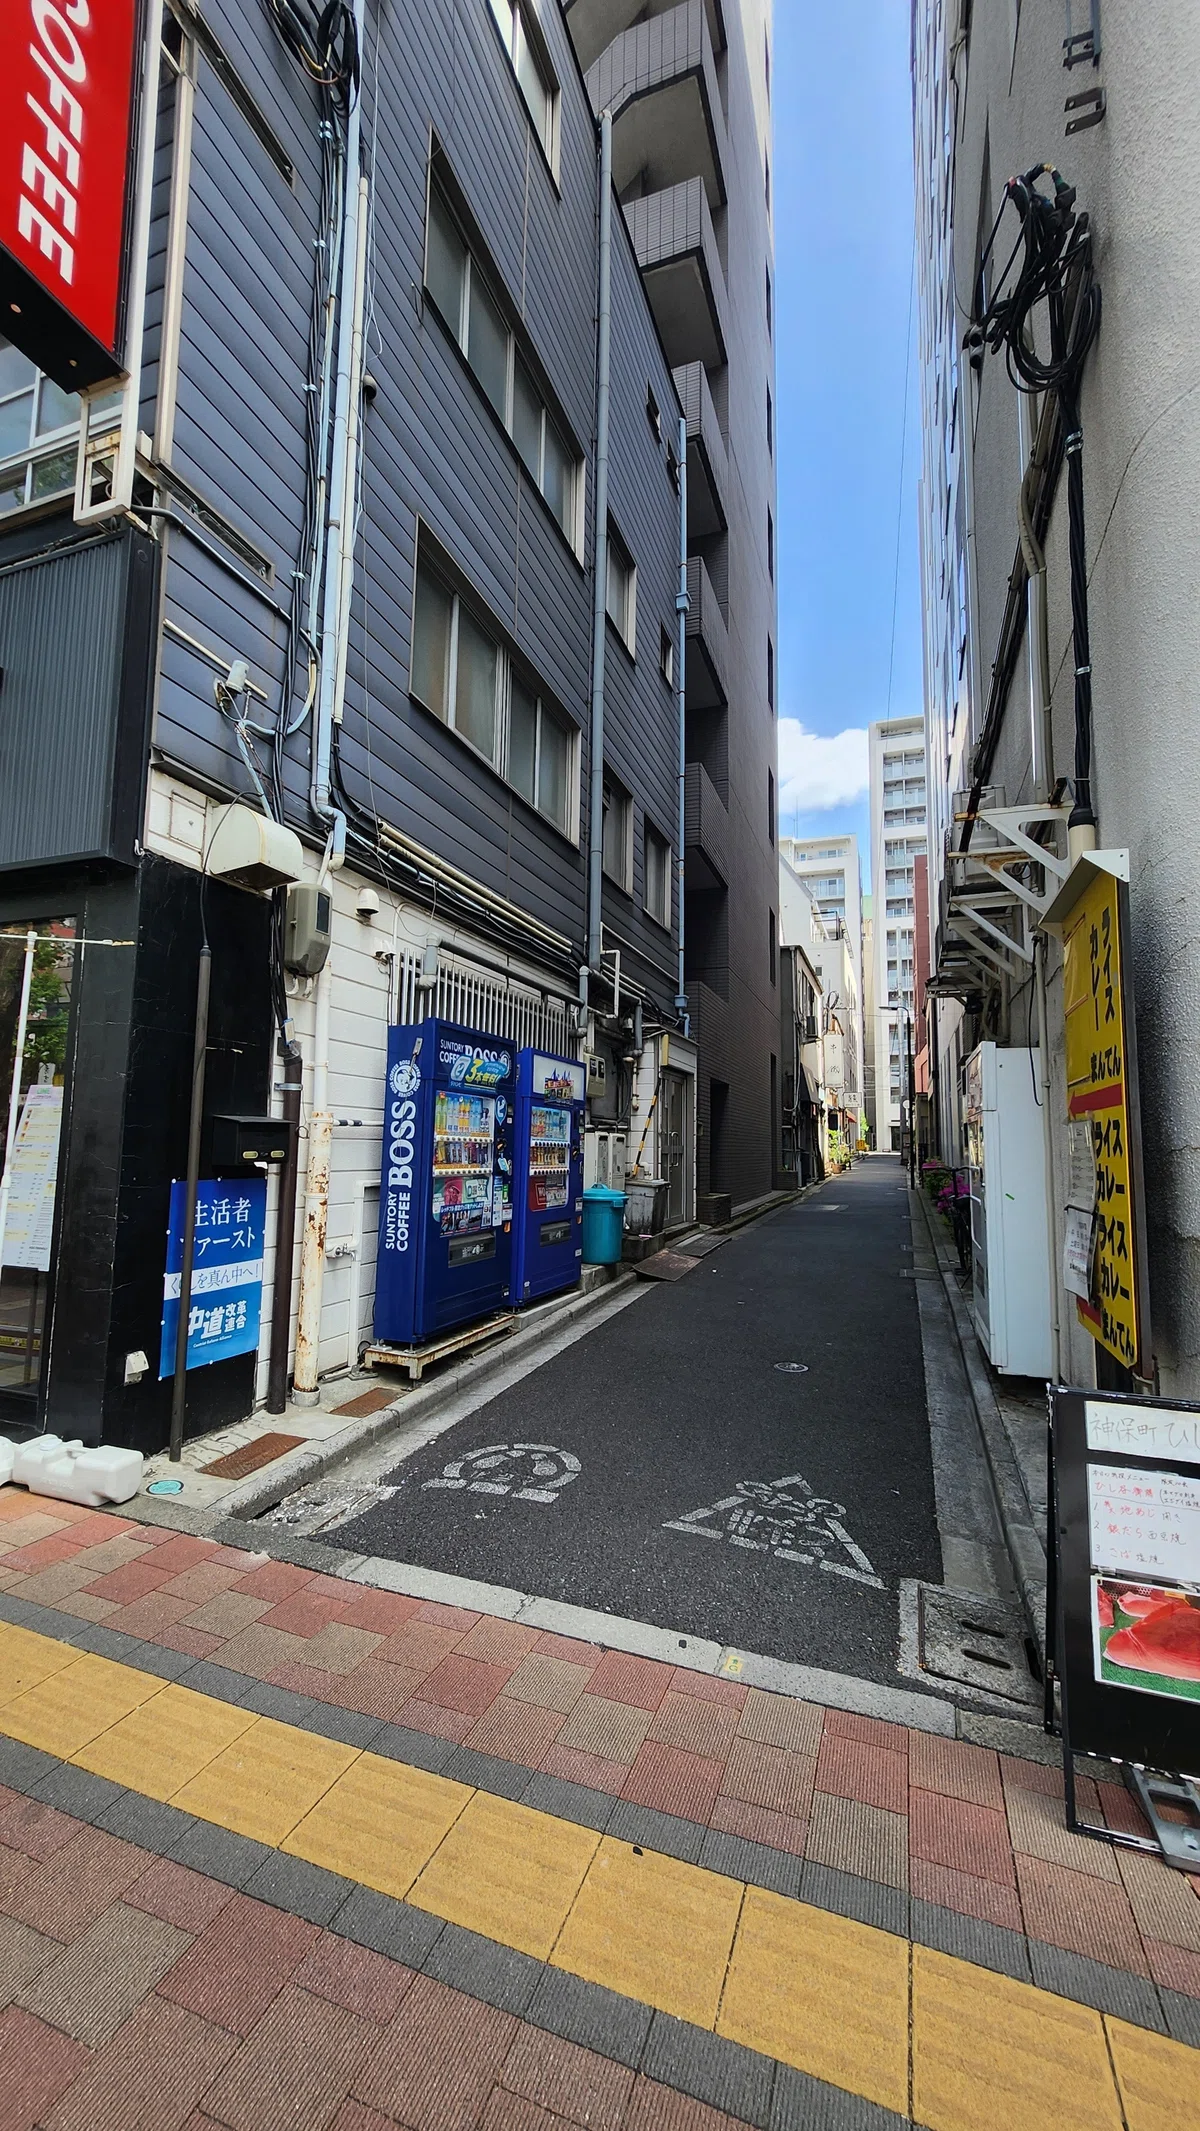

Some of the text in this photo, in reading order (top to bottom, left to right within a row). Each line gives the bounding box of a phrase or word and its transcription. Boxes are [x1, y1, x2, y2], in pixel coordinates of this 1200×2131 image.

[1090, 923, 1100, 1032] カレー
[1102, 906, 1115, 1024] ライス
[439, 1050, 461, 1065] COFF
[440, 1039, 465, 1053] SUNTORY
[1090, 1045, 1121, 1084] まんてん
[388, 1100, 416, 1188] BOSS
[1096, 1162, 1126, 1204] カレー
[385, 1191, 397, 1250] SUNTORY
[396, 1192, 411, 1252] COFFEE
[1100, 1214, 1129, 1263] ライス
[179, 1226, 257, 1258] ァースト
[170, 1264, 259, 1295] くを真ん中へ!
[1101, 1256, 1130, 1301] カレー
[224, 1315, 247, 1333] 連合
[225, 1300, 247, 1316] 改革
[1102, 1309, 1135, 1359] まんてん
[1089, 1412, 1158, 1446] 神保町
